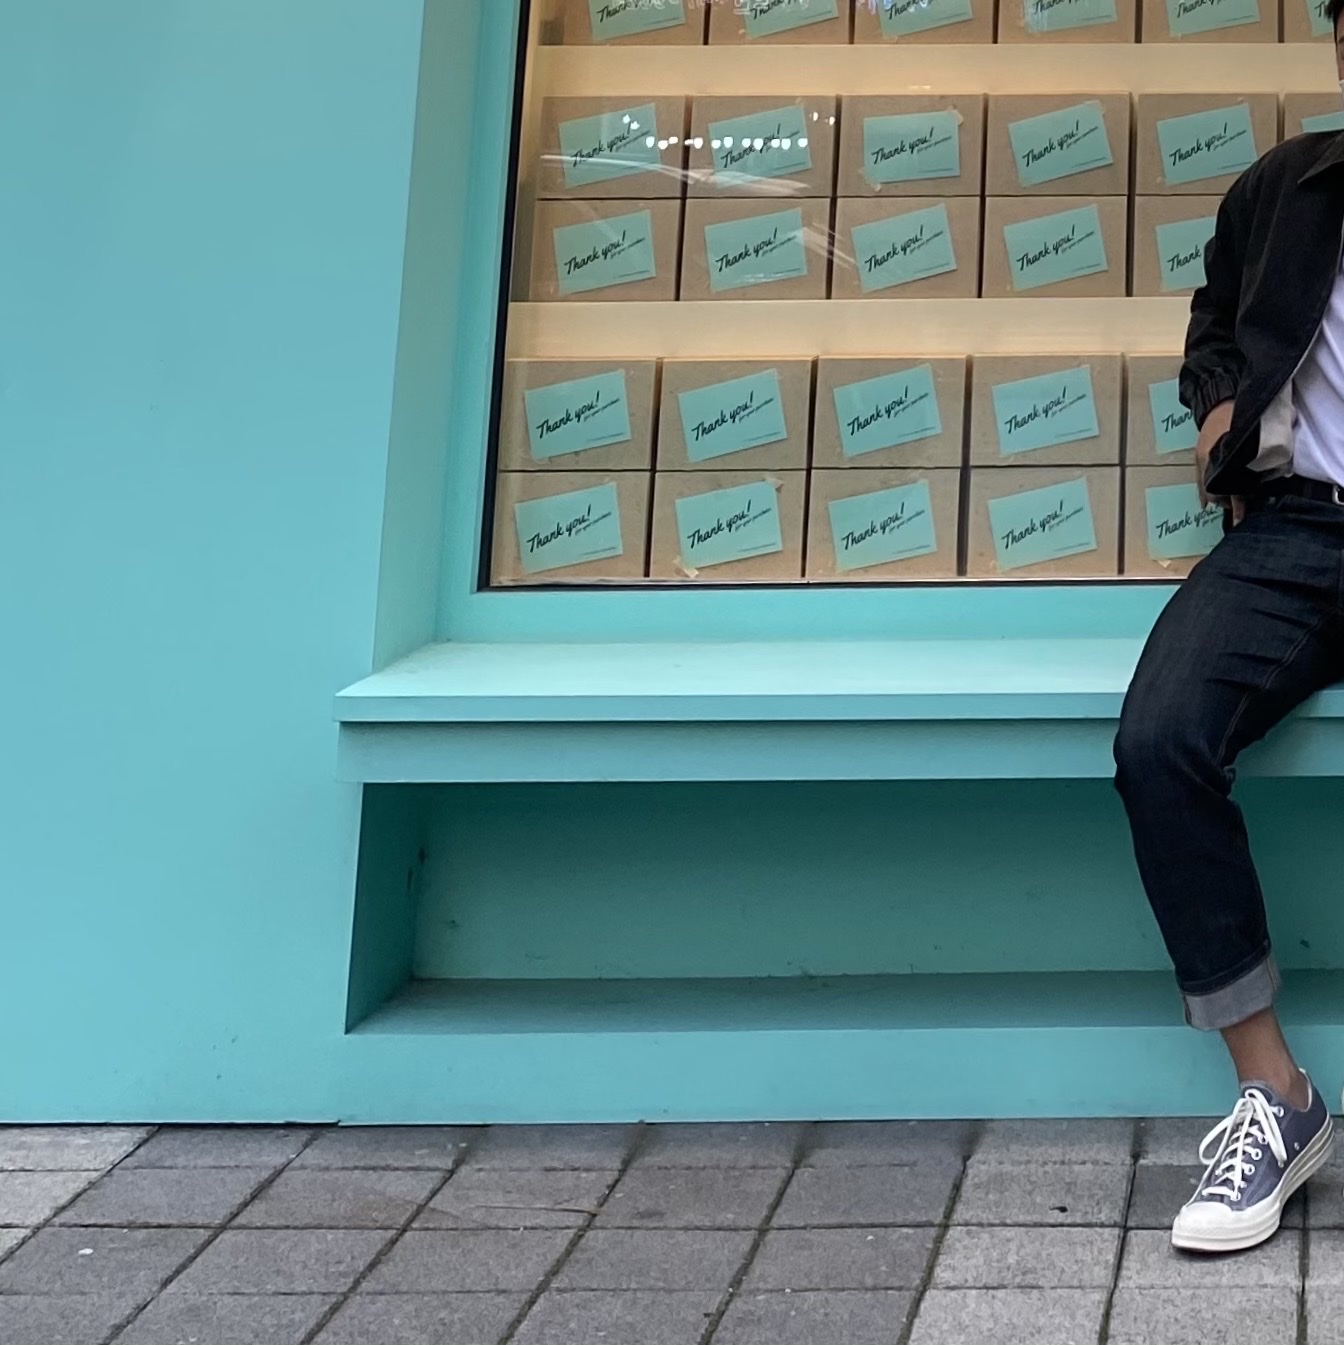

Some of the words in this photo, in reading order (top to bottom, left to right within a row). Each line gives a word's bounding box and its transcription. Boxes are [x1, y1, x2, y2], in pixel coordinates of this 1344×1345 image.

[607, 121, 631, 153] you!
[873, 139, 907, 164] Thank
[909, 127, 934, 153] you!
[1022, 137, 1056, 167] Thank
[1058, 120, 1079, 150] you!
[1169, 138, 1203, 166] Thank
[1204, 123, 1227, 152] you!
[564, 246, 599, 274] Thank
[600, 230, 626, 259] you!
[715, 243, 752, 272] Thank
[752, 227, 778, 256] you!
[864, 243, 900, 272] Thank
[901, 225, 924, 255] you!
[1017, 243, 1052, 271] Thank
[1053, 225, 1075, 255] you!
[1167, 245, 1202, 271] Thank
[536, 408, 573, 439] Thank
[575, 390, 600, 423] you!
[692, 409, 729, 441] Thank
[729, 390, 754, 423] you!
[847, 404, 883, 436] Thank
[884, 385, 908, 416] you!
[1004, 405, 1040, 435] Thank
[1041, 385, 1066, 416] you!
[1161, 408, 1193, 432] Than
[527, 522, 564, 553] Thank
[565, 504, 591, 537] you!
[688, 517, 725, 549] Thank
[725, 500, 751, 532] you!
[841, 519, 878, 550] Thank
[879, 501, 906, 533] you!
[1001, 518, 1040, 550] Thank
[1040, 499, 1064, 531] you!
[1156, 511, 1193, 539] Thank
